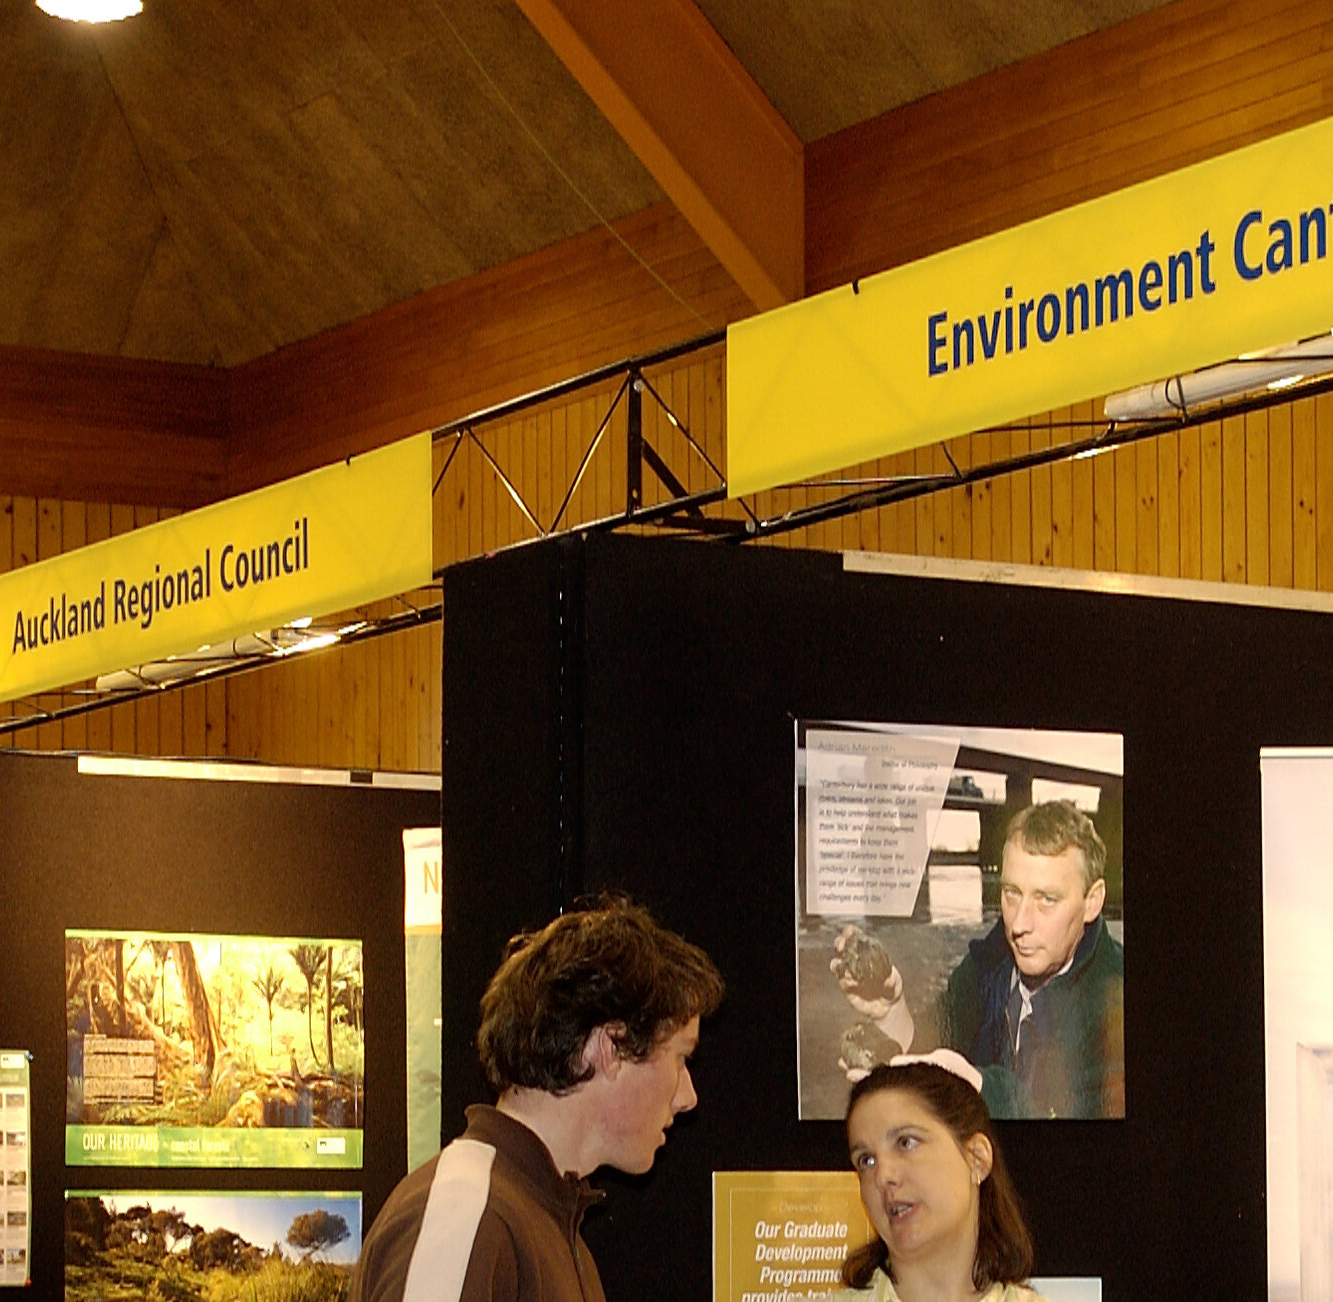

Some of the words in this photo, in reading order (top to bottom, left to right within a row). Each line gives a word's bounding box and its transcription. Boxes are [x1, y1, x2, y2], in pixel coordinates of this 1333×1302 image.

[927, 229, 1216, 378] Environment
[13, 581, 105, 654] Auckland
[113, 548, 211, 630] Regional
[220, 517, 309, 592] Council
[423, 861, 439, 894] N
[82, 1133, 105, 1151] OUR
[109, 1133, 160, 1152] HERITAGE
[755, 1220, 781, 1239] Our
[784, 1220, 848, 1239] Graduate
[755, 1243, 848, 1265] Development
